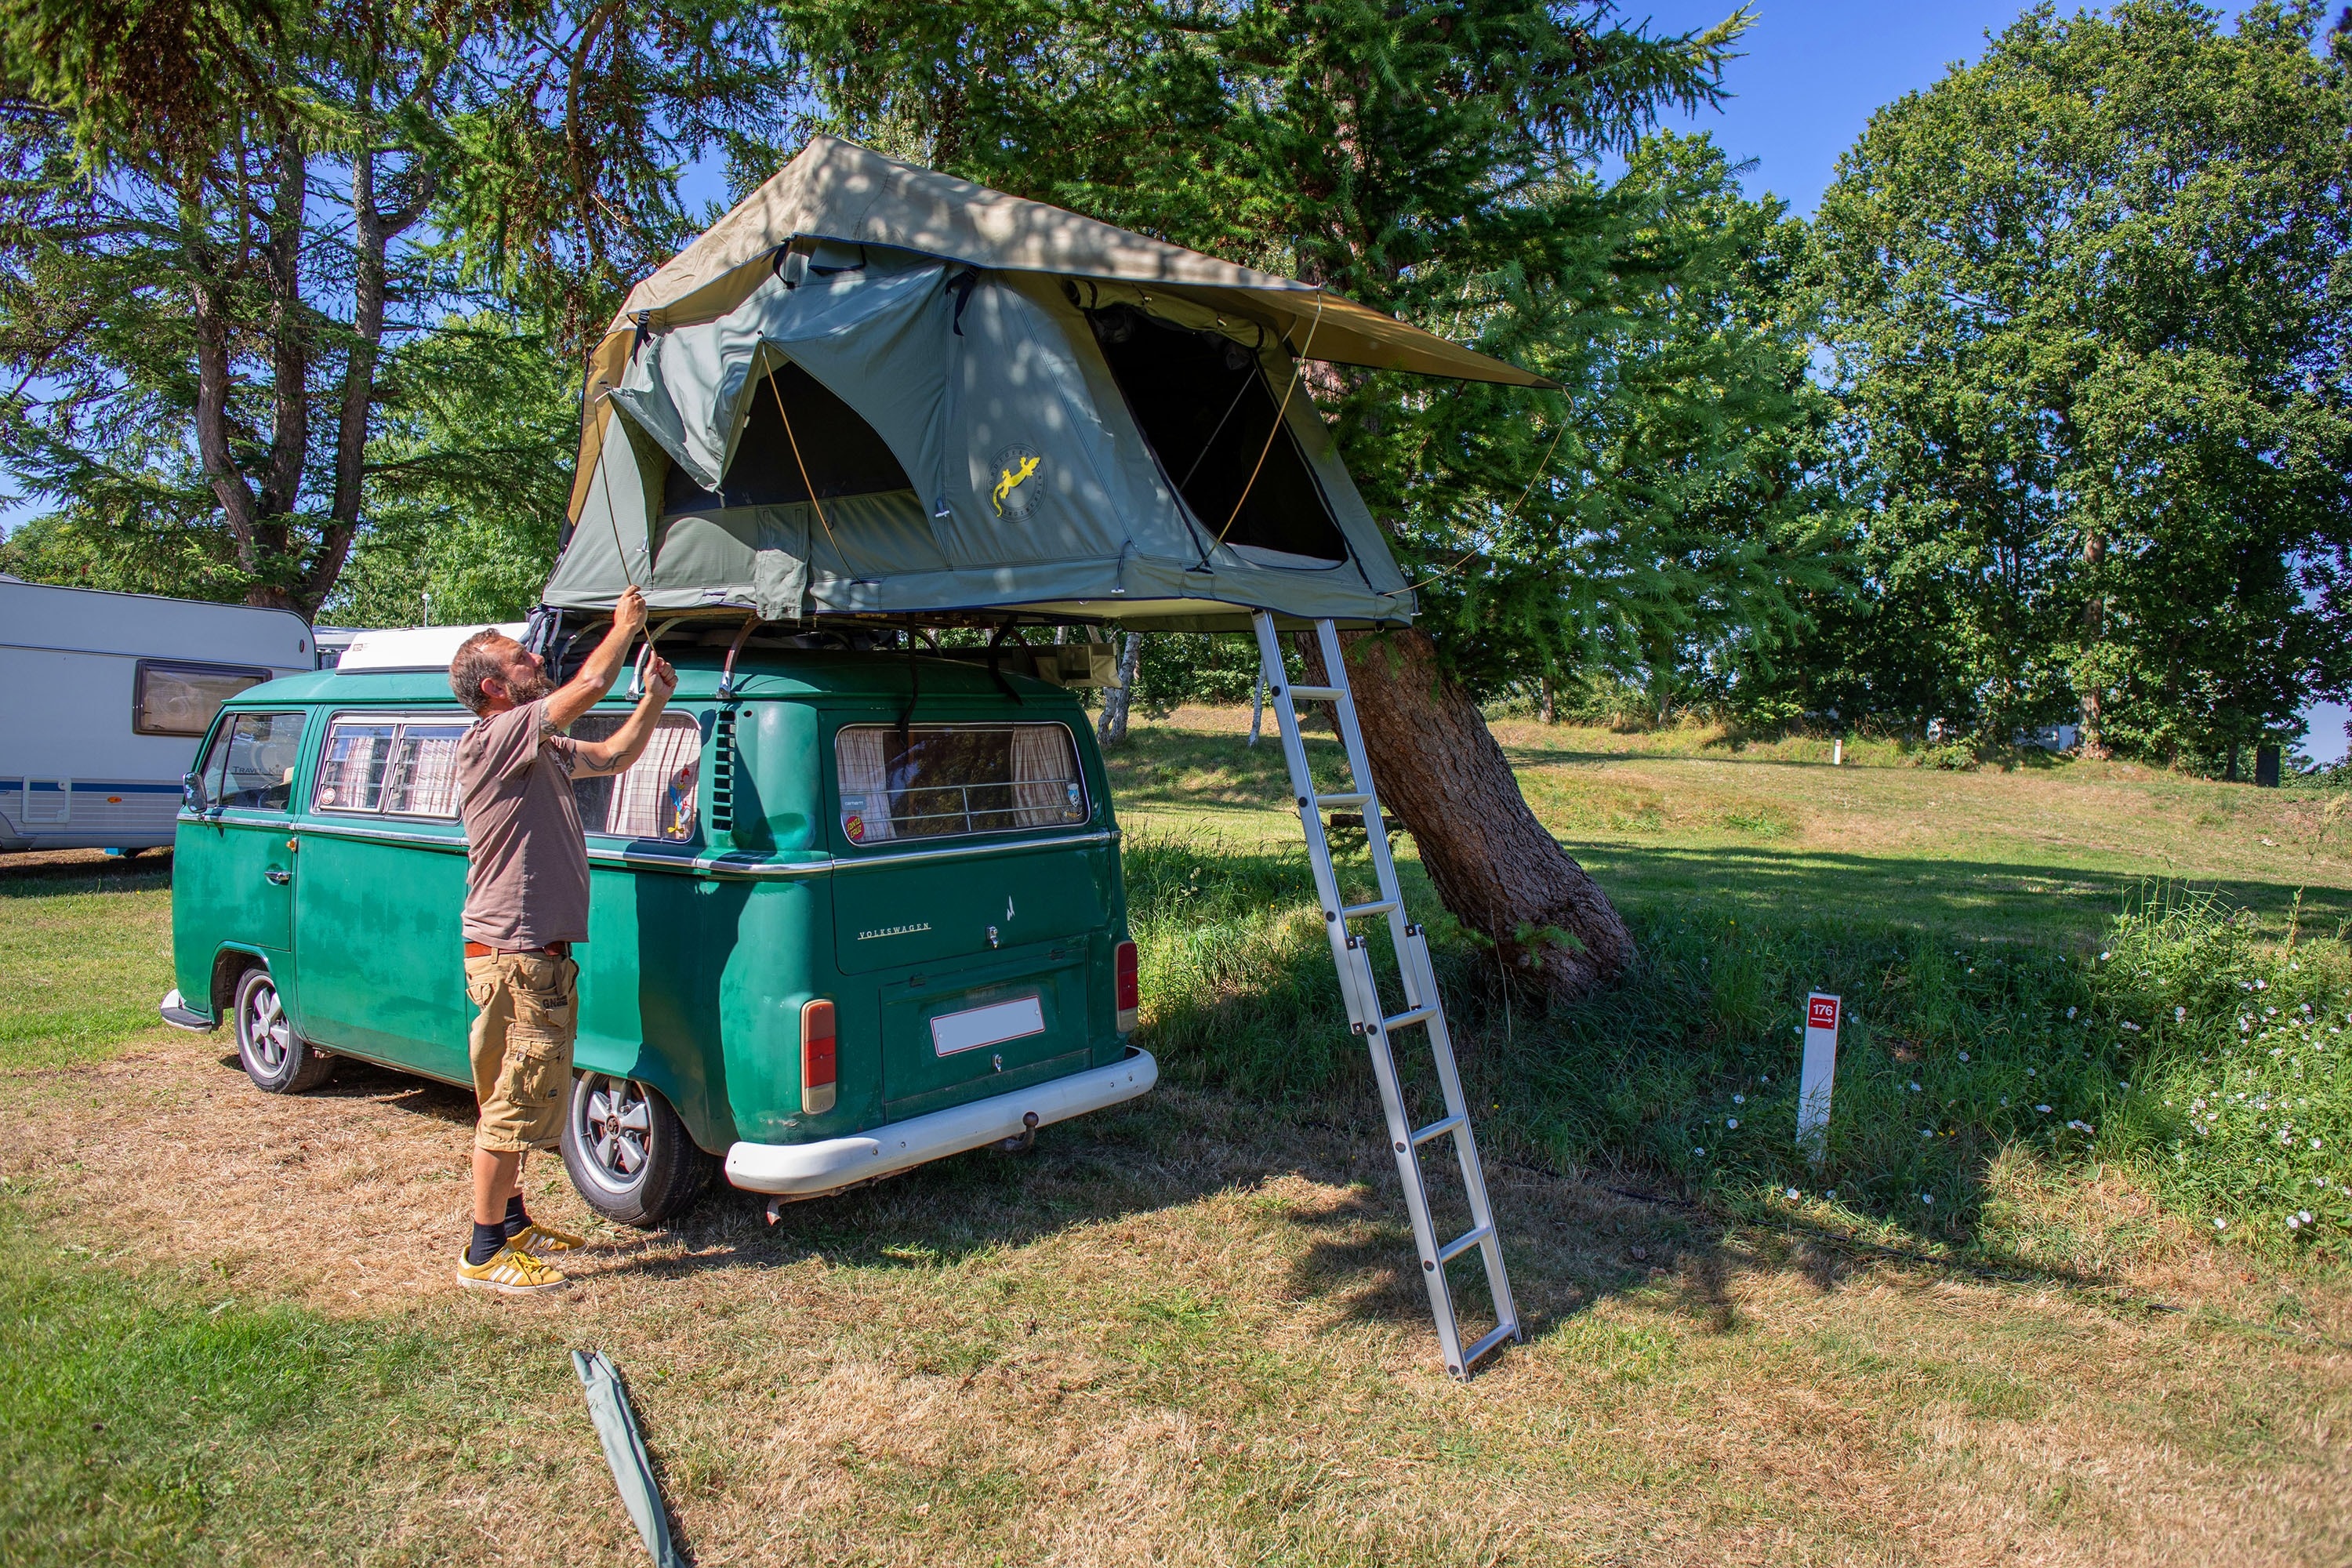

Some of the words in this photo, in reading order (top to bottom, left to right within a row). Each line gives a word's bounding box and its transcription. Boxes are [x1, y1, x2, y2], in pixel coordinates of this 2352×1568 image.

[847, 817, 861, 832] SANTA
[859, 922, 929, 939] VOLKSWAGEN
[1813, 1004, 1833, 1016] 176
